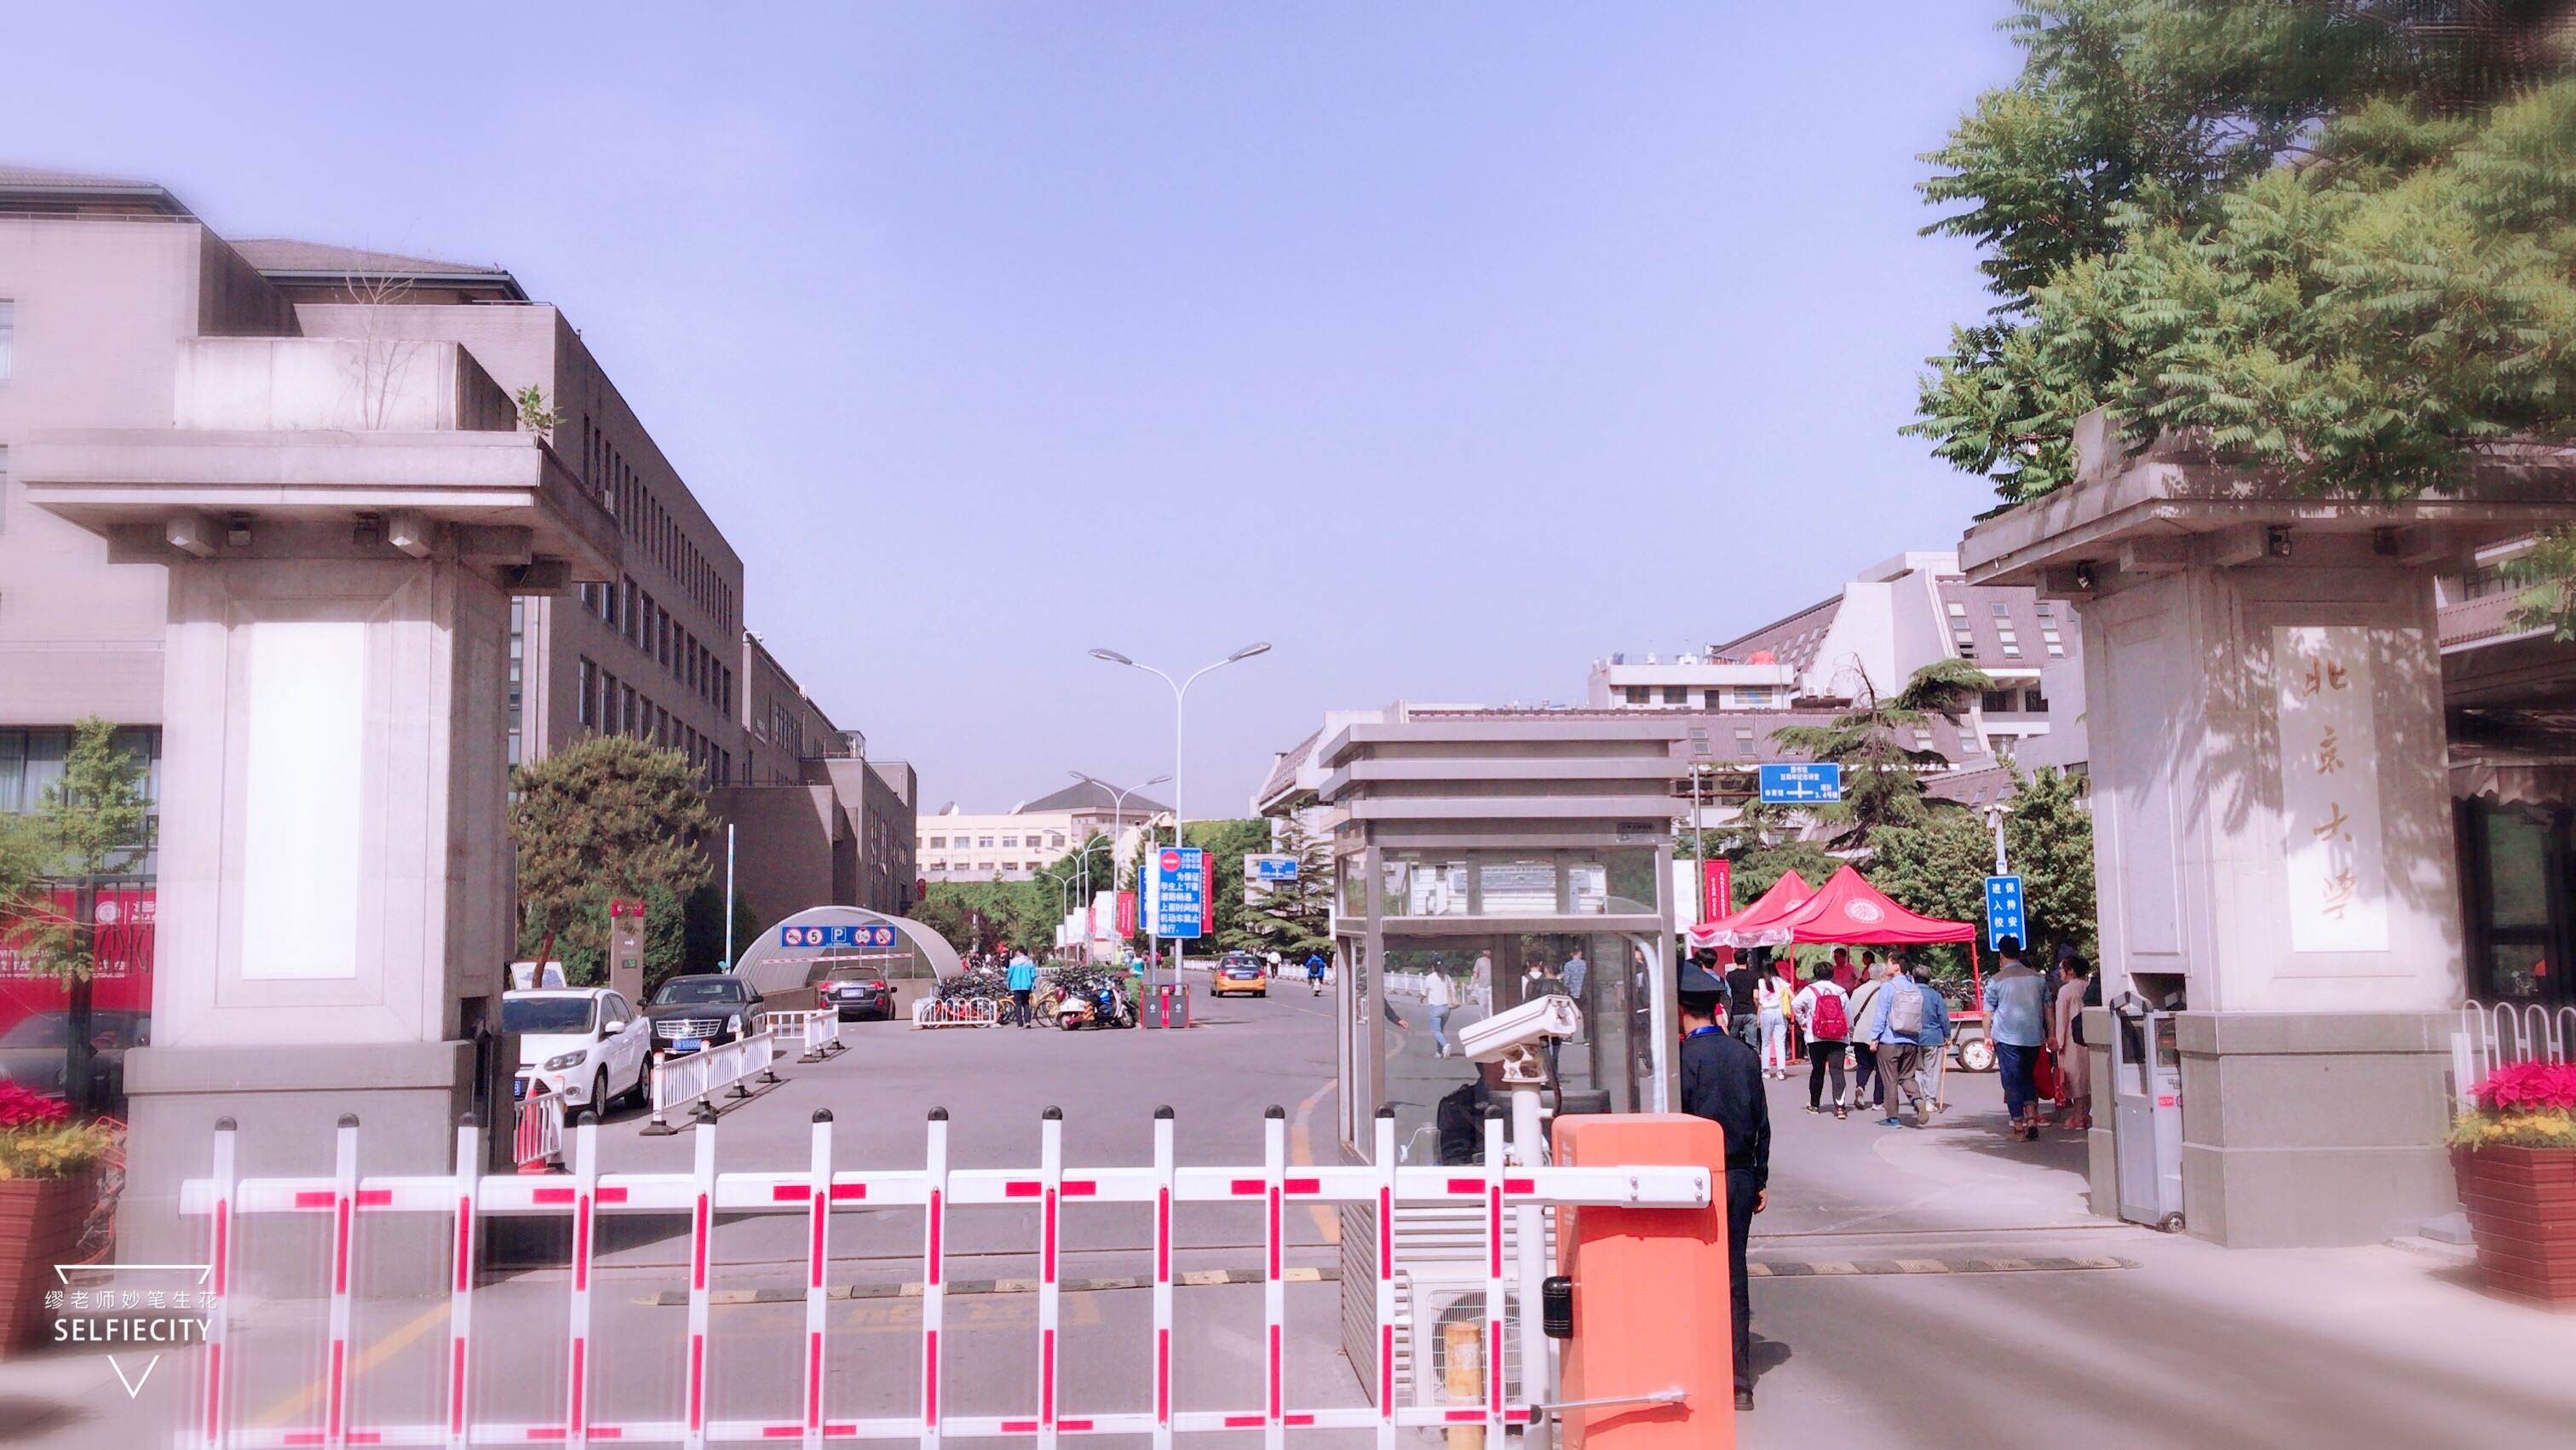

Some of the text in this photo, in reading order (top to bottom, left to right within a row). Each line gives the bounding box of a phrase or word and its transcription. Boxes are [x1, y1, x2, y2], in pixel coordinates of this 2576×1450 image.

[1160, 882, 1199, 891] 学生上下课
[812, 932, 818, 941] 5
[834, 929, 843, 941] P
